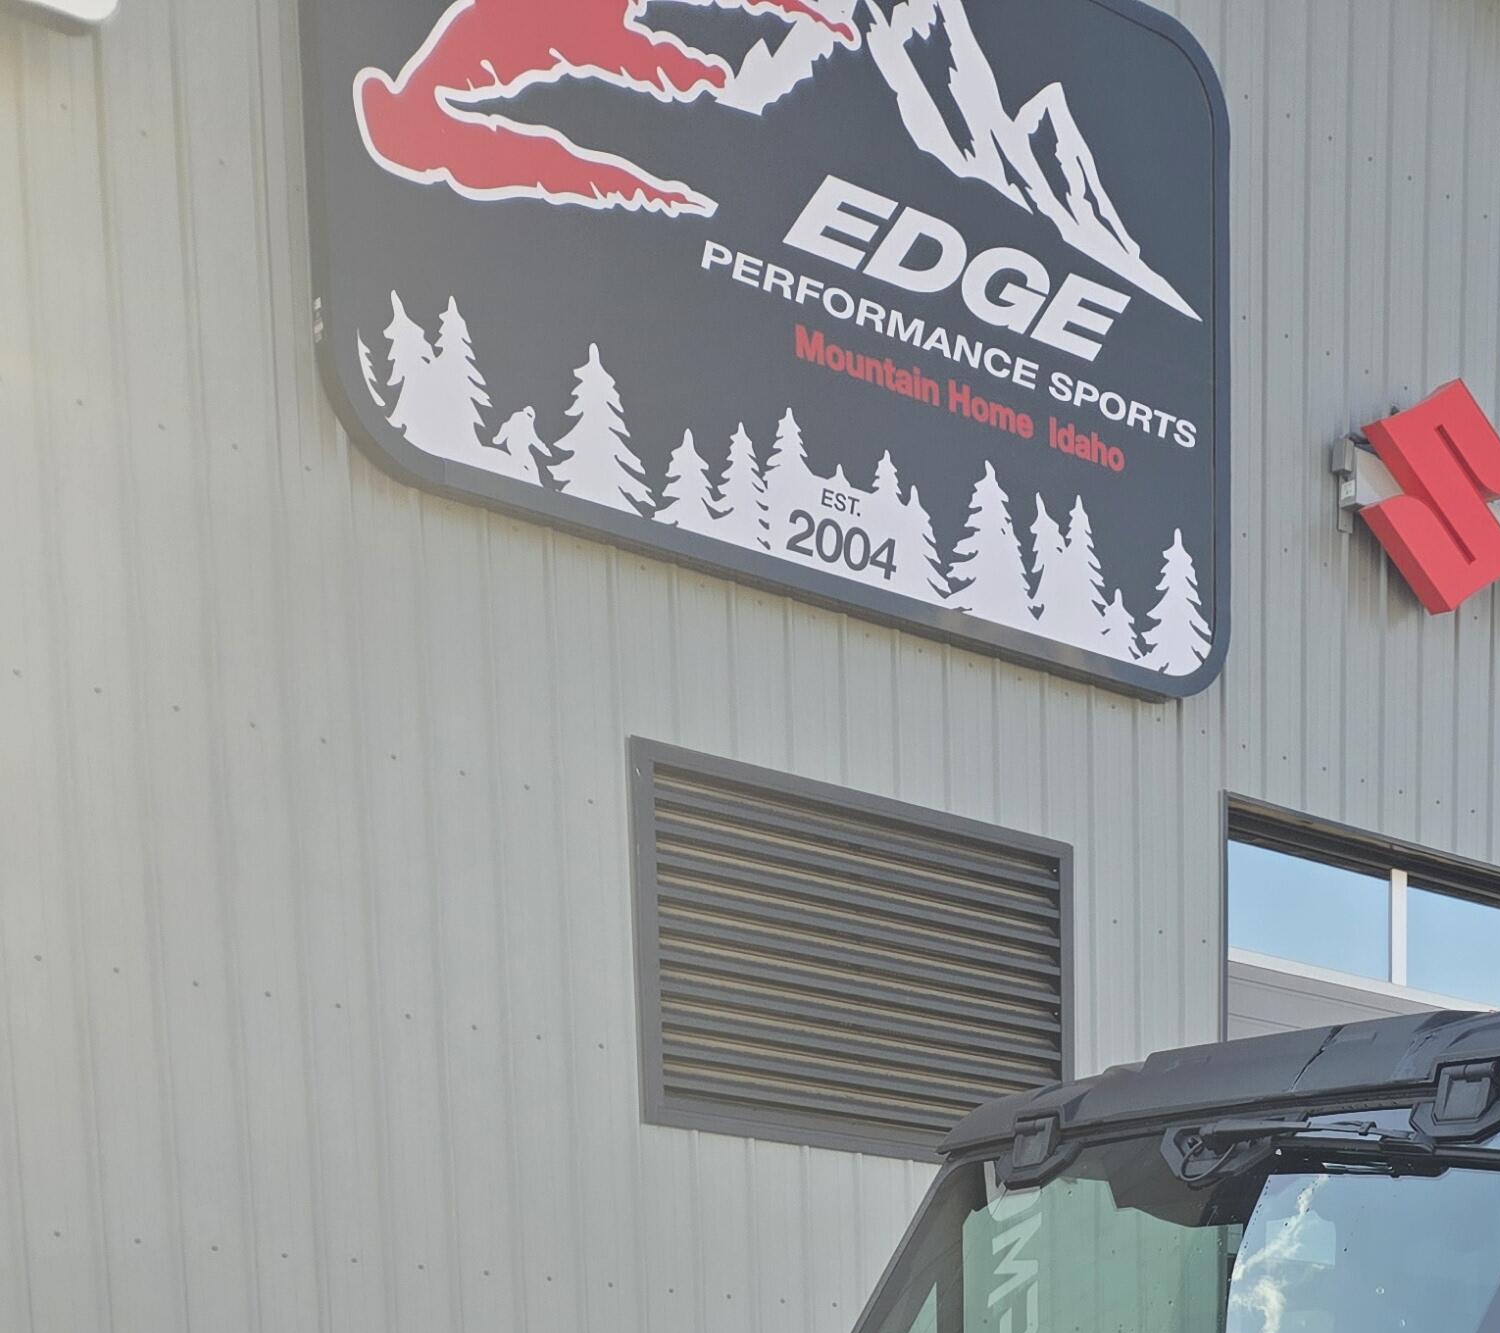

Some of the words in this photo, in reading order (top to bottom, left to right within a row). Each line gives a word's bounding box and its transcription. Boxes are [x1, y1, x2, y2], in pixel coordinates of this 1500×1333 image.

[782, 174, 1131, 362] EDGE
[700, 239, 1040, 389] PERFORMANCE
[1048, 370, 1197, 448] SPORTS
[794, 324, 940, 406] Mountain
[948, 379, 1034, 439] Home
[1048, 416, 1125, 472] Idaho
[786, 510, 897, 580] 2004
[820, 488, 862, 517] EST.
